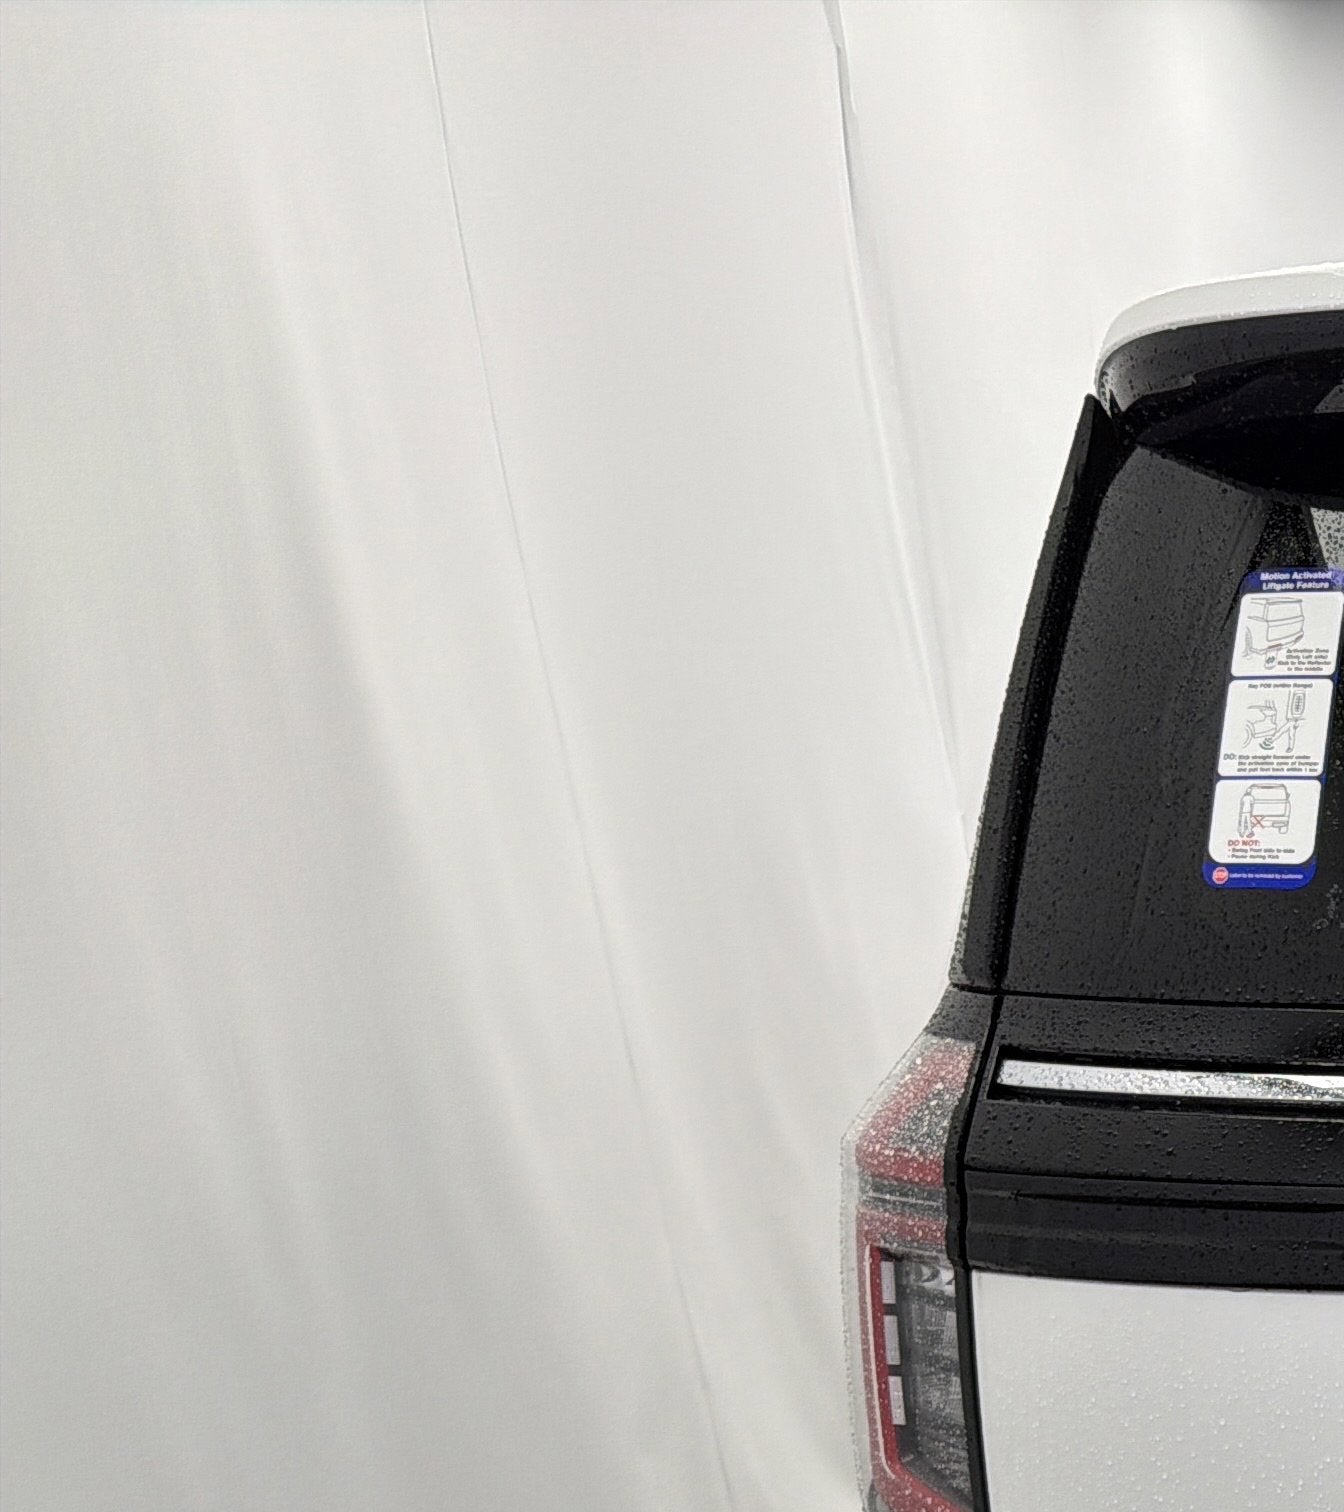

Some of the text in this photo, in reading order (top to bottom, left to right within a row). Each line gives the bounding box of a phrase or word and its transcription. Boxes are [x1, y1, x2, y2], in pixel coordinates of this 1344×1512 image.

[1260, 571, 1332, 580] Motion Activated
[1262, 581, 1329, 590] Liftgate Feature
